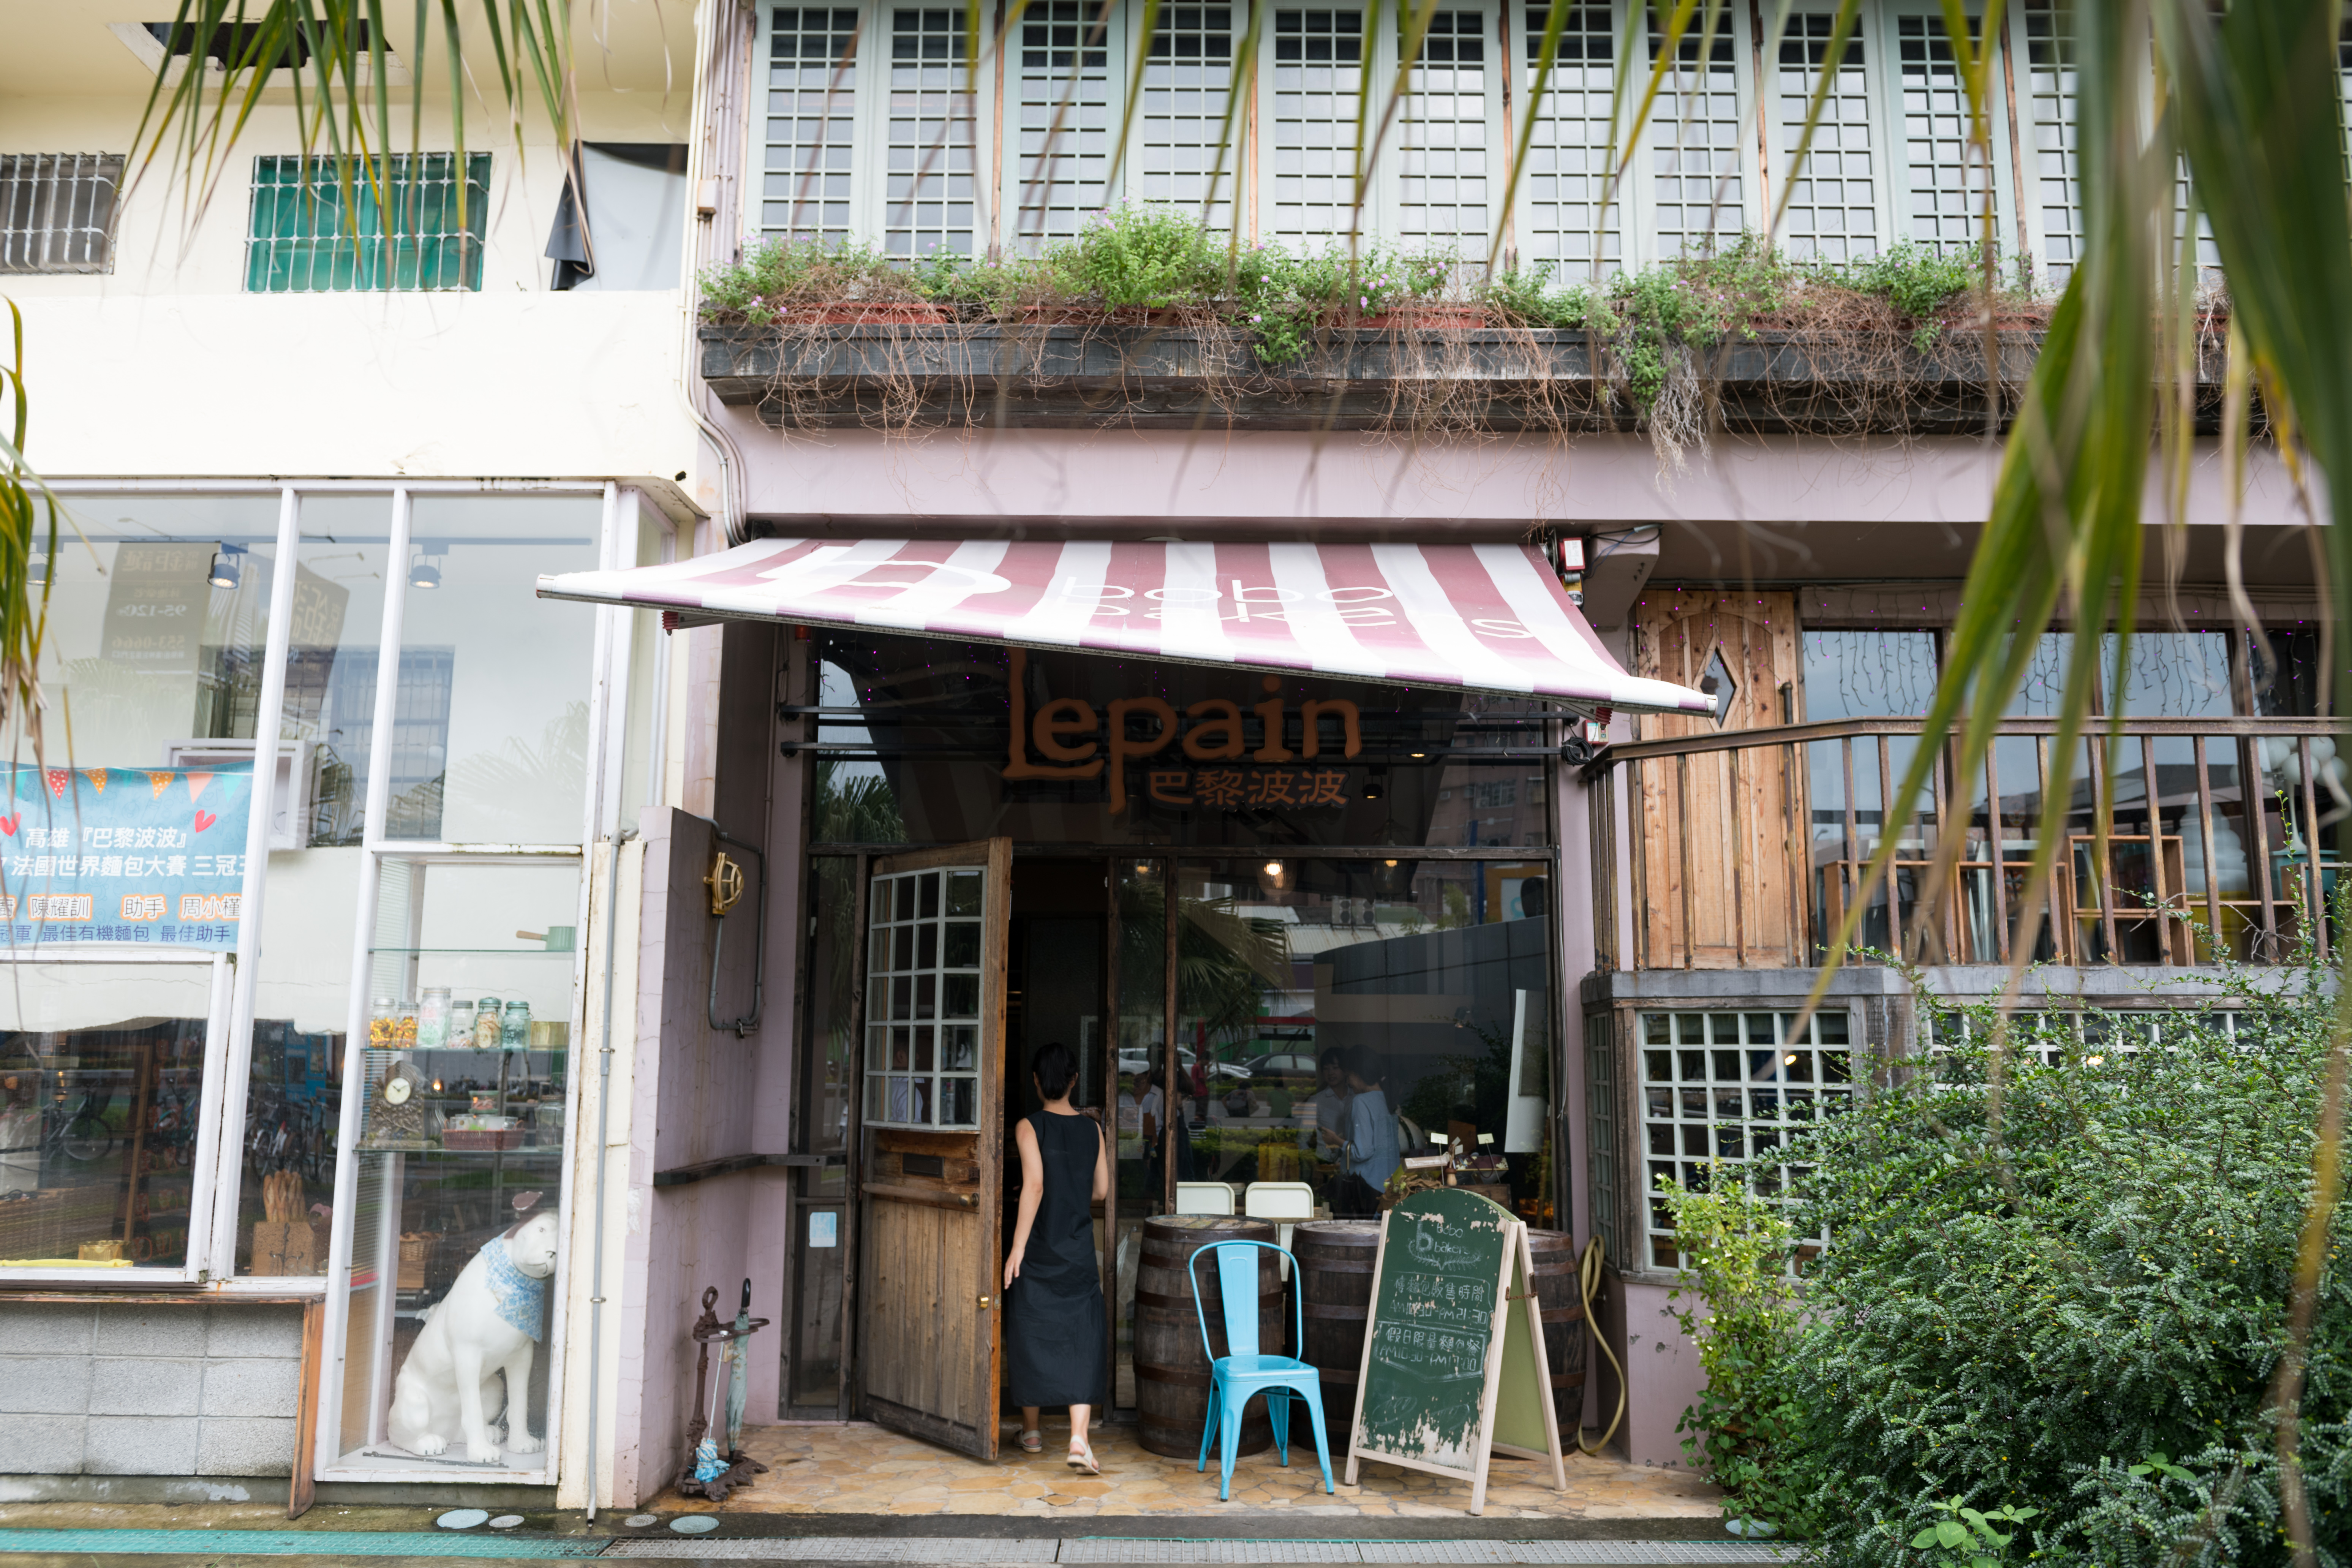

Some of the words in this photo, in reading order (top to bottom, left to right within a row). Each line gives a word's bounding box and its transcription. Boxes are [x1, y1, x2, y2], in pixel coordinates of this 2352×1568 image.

[1061, 576, 1394, 603] bobo
[1149, 770, 1349, 807] 巴黎波波
[31, 897, 90, 918] 陳耀訓
[123, 897, 164, 917] 助手
[42, 925, 150, 942] 最佳有機麵包
[160, 925, 231, 942] 最佳助手
[1436, 1223, 1464, 1238] bobo
